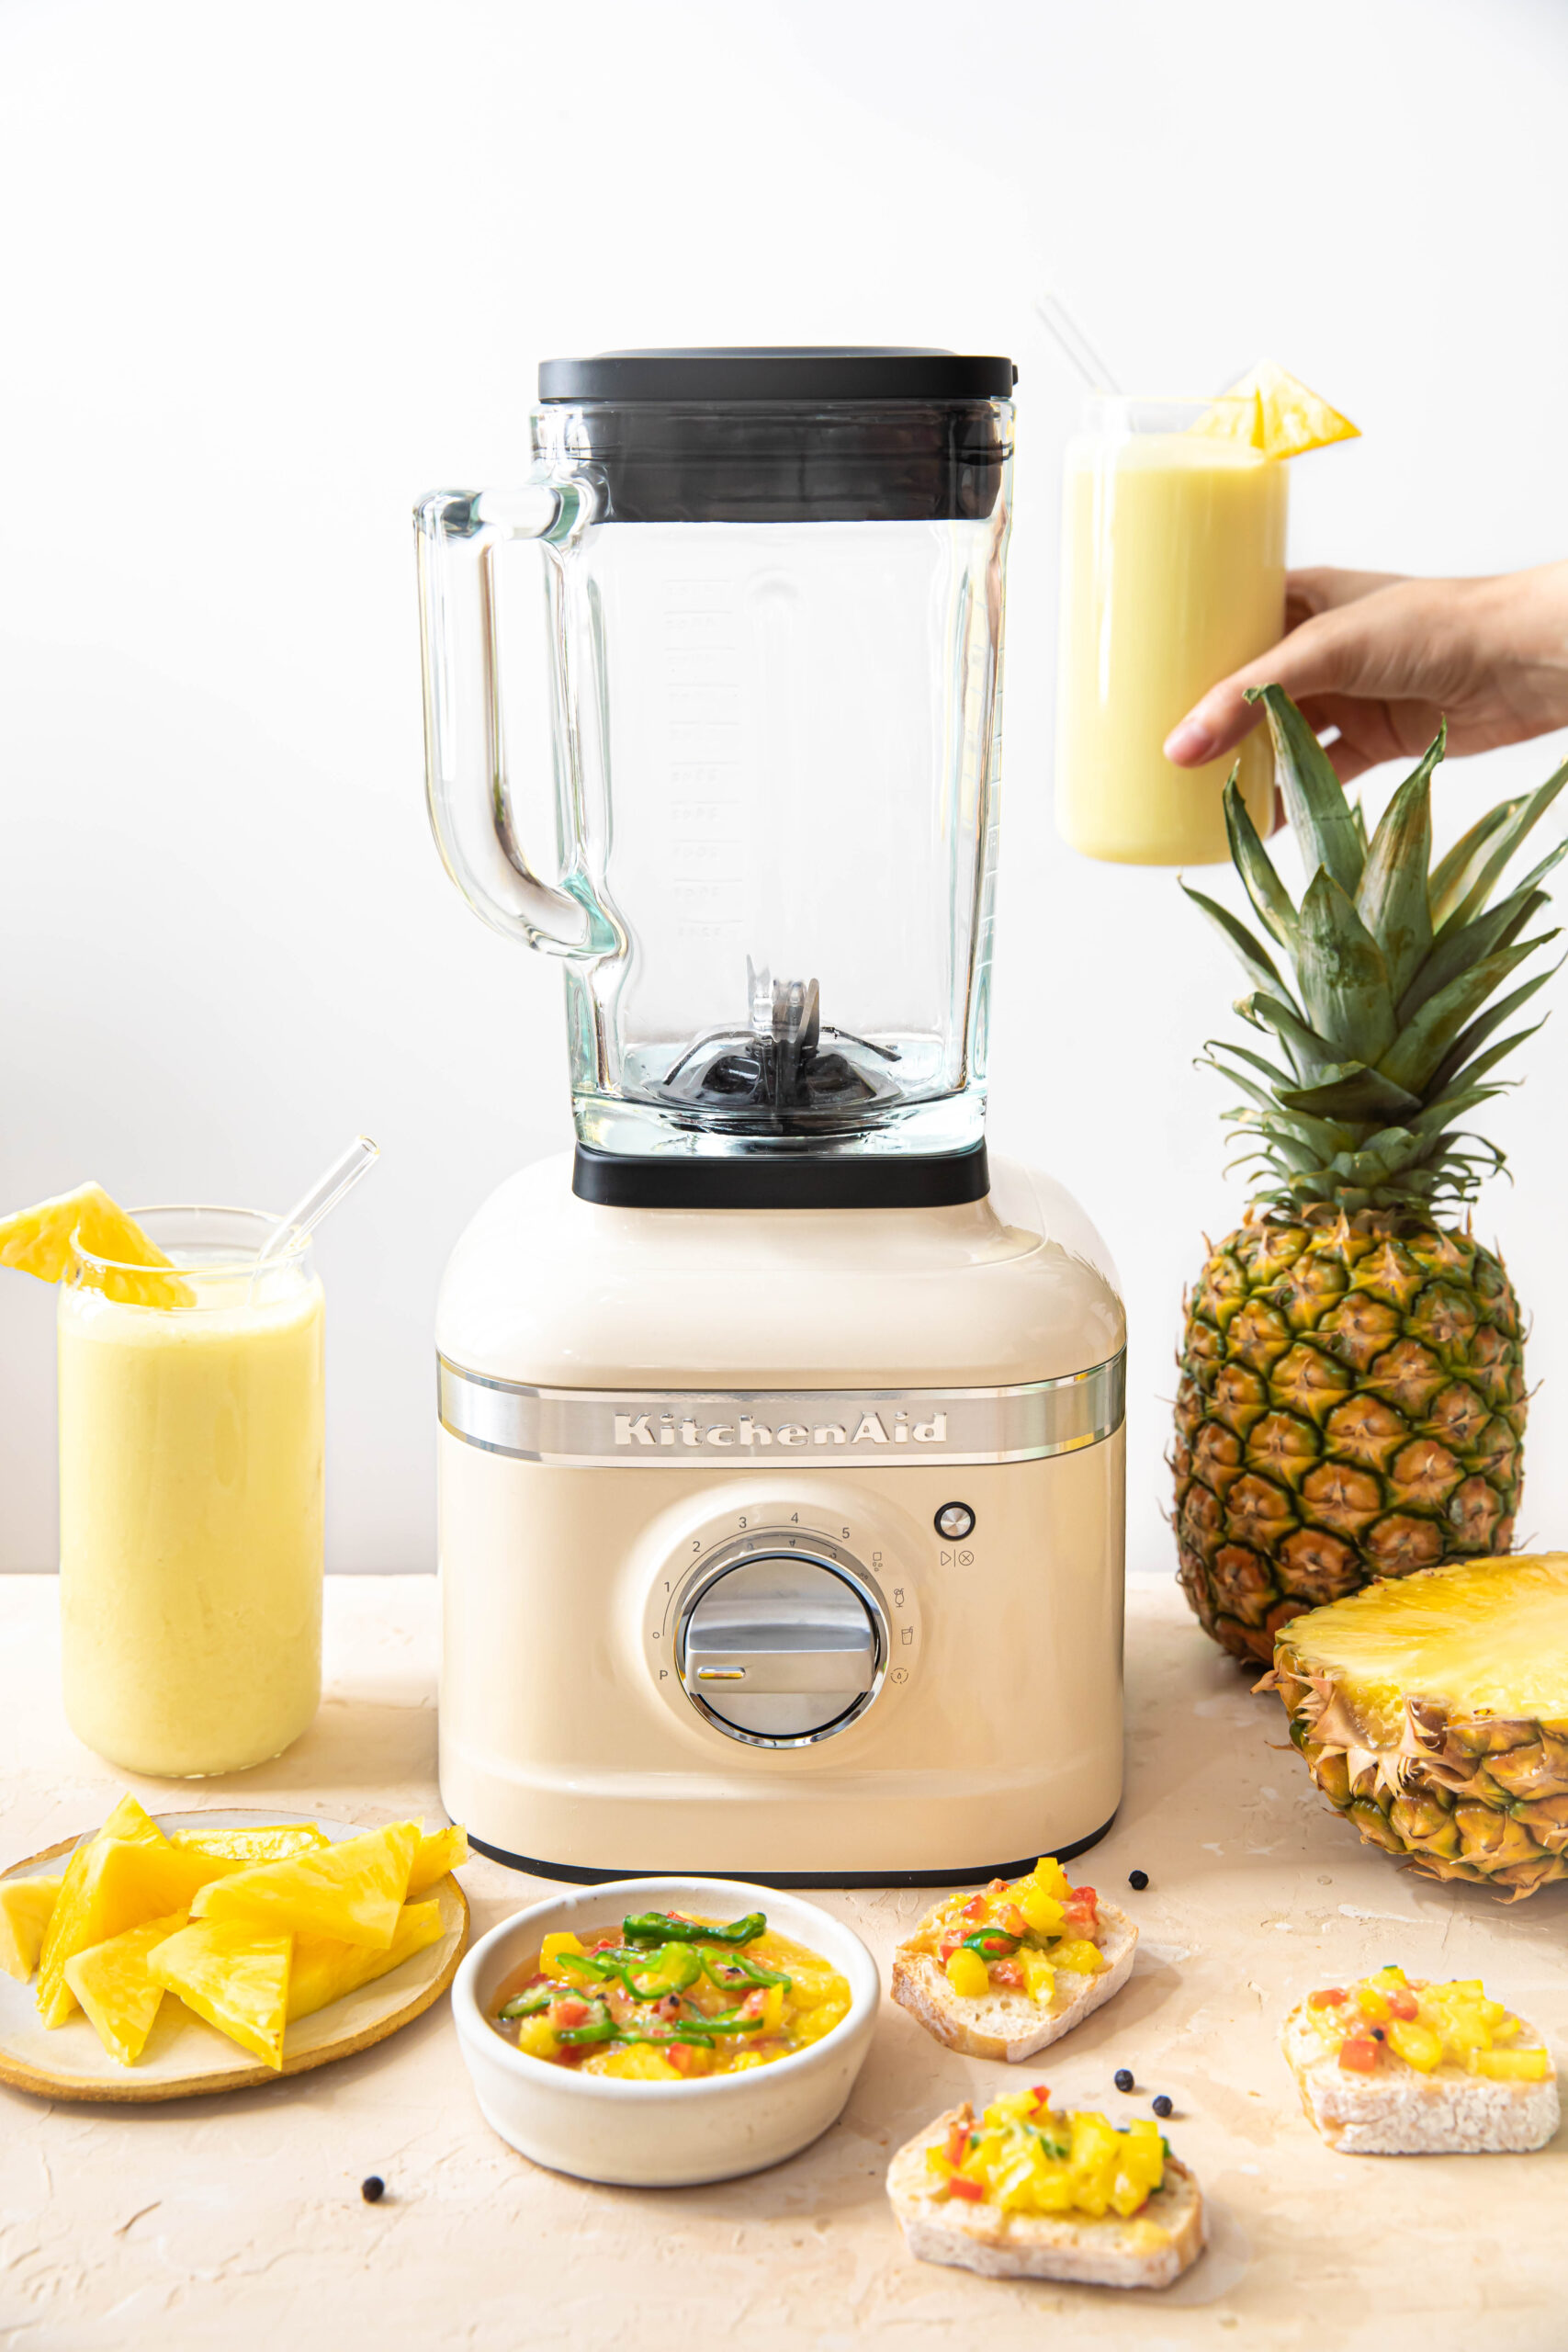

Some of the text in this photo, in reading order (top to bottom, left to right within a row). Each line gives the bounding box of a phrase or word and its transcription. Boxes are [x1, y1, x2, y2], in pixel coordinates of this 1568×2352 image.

[614, 1410, 948, 1447] KitchenAid
[664, 1512, 851, 1592] 1 2 3 4 5
[660, 1669, 669, 1680] P
